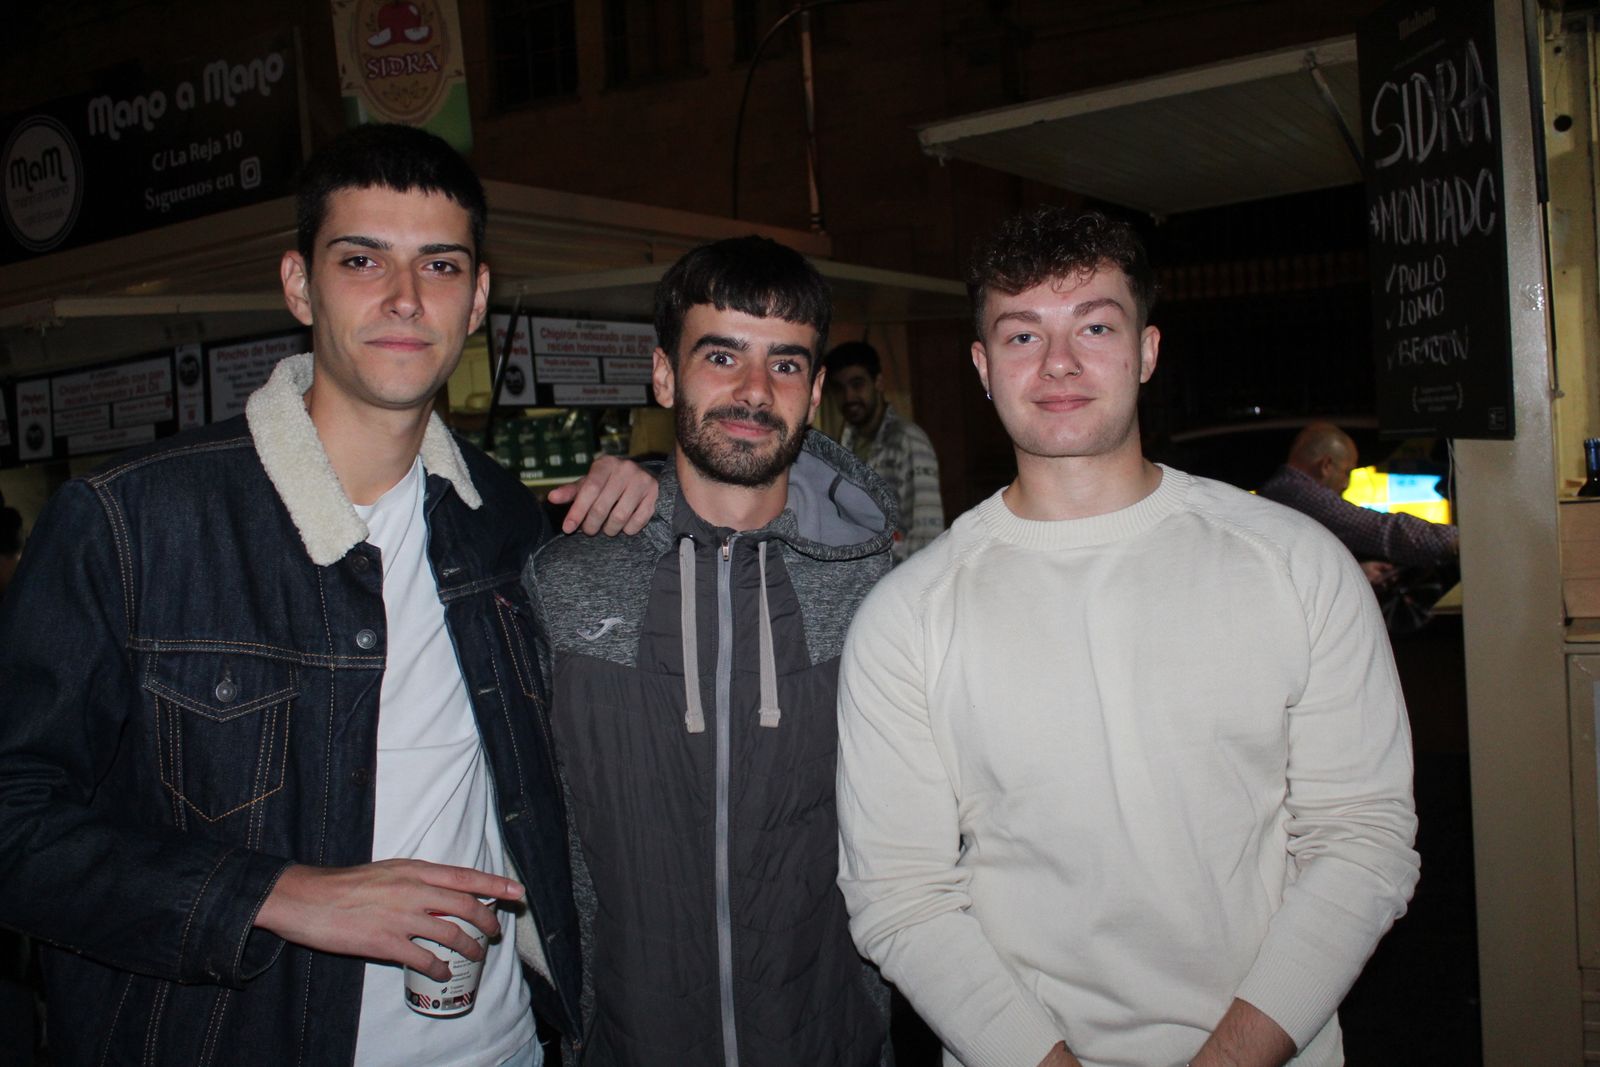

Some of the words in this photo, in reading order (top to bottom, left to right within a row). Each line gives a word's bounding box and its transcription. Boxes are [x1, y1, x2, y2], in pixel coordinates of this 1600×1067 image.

[367, 51, 440, 80] SIDRA
[87, 89, 168, 141] Mano
[176, 81, 195, 111] a
[203, 52, 285, 107] Mano
[1370, 38, 1495, 169] SIDRA
[190, 136, 222, 161] Reja
[224, 129, 243, 151] 10
[216, 173, 235, 190] en
[1398, 254, 1446, 295] POLLO
[1398, 286, 1445, 327] LOMO
